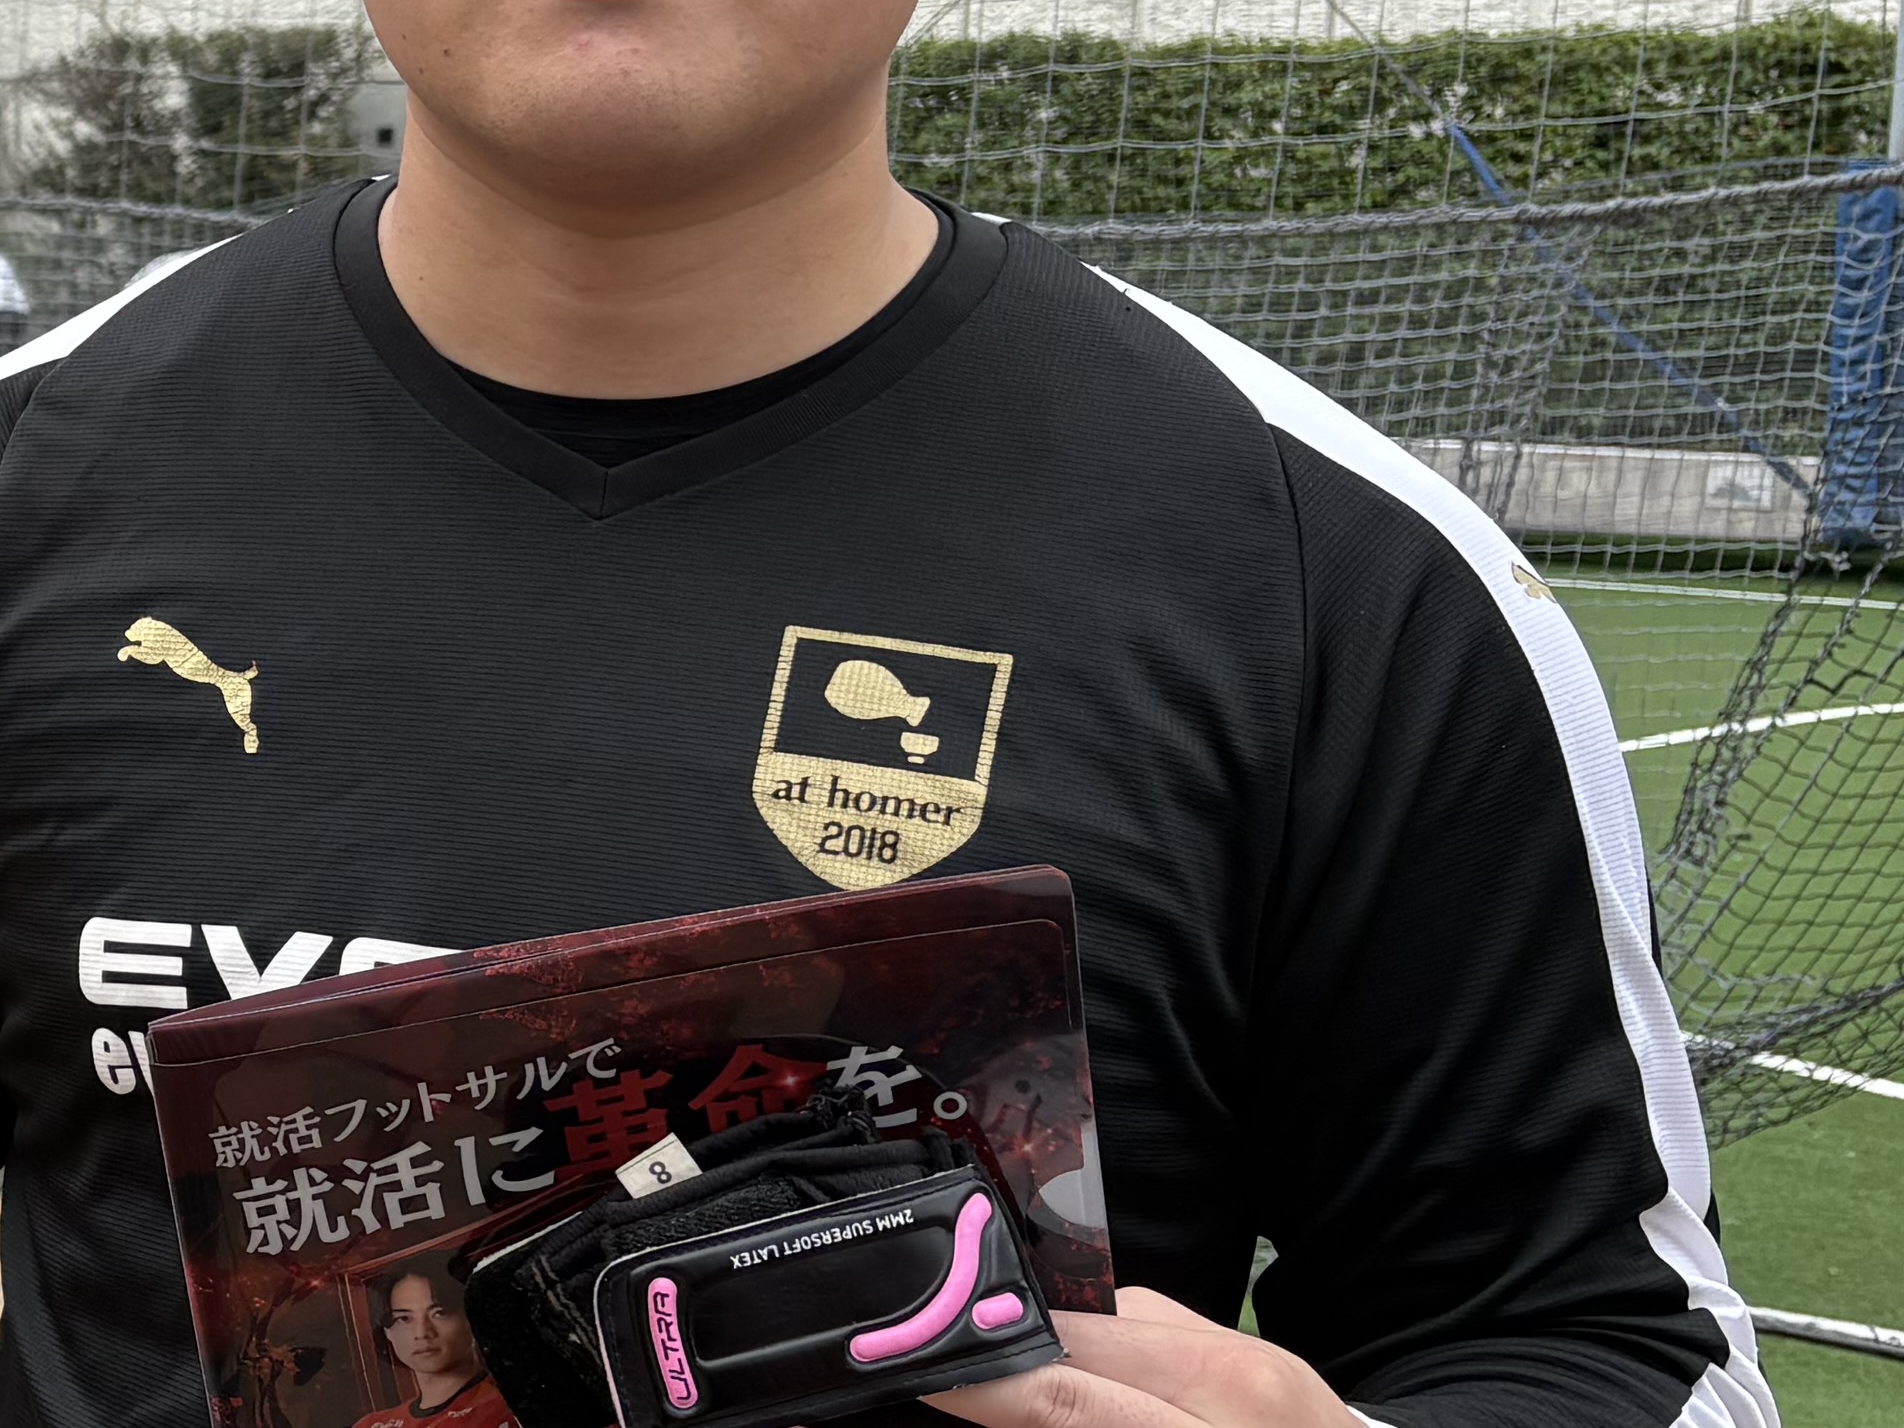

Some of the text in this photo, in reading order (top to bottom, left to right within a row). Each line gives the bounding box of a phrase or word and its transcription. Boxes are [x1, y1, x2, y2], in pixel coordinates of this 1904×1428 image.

[771, 775, 963, 826] at homer
[818, 821, 900, 864] 2018
[209, 1036, 624, 1169] 就活フットサルで
[648, 1160, 673, 1185] 8
[729, 1208, 914, 1270] 2MM SUPERSOFT LATEX
[653, 1291, 692, 1401] ULTRA
